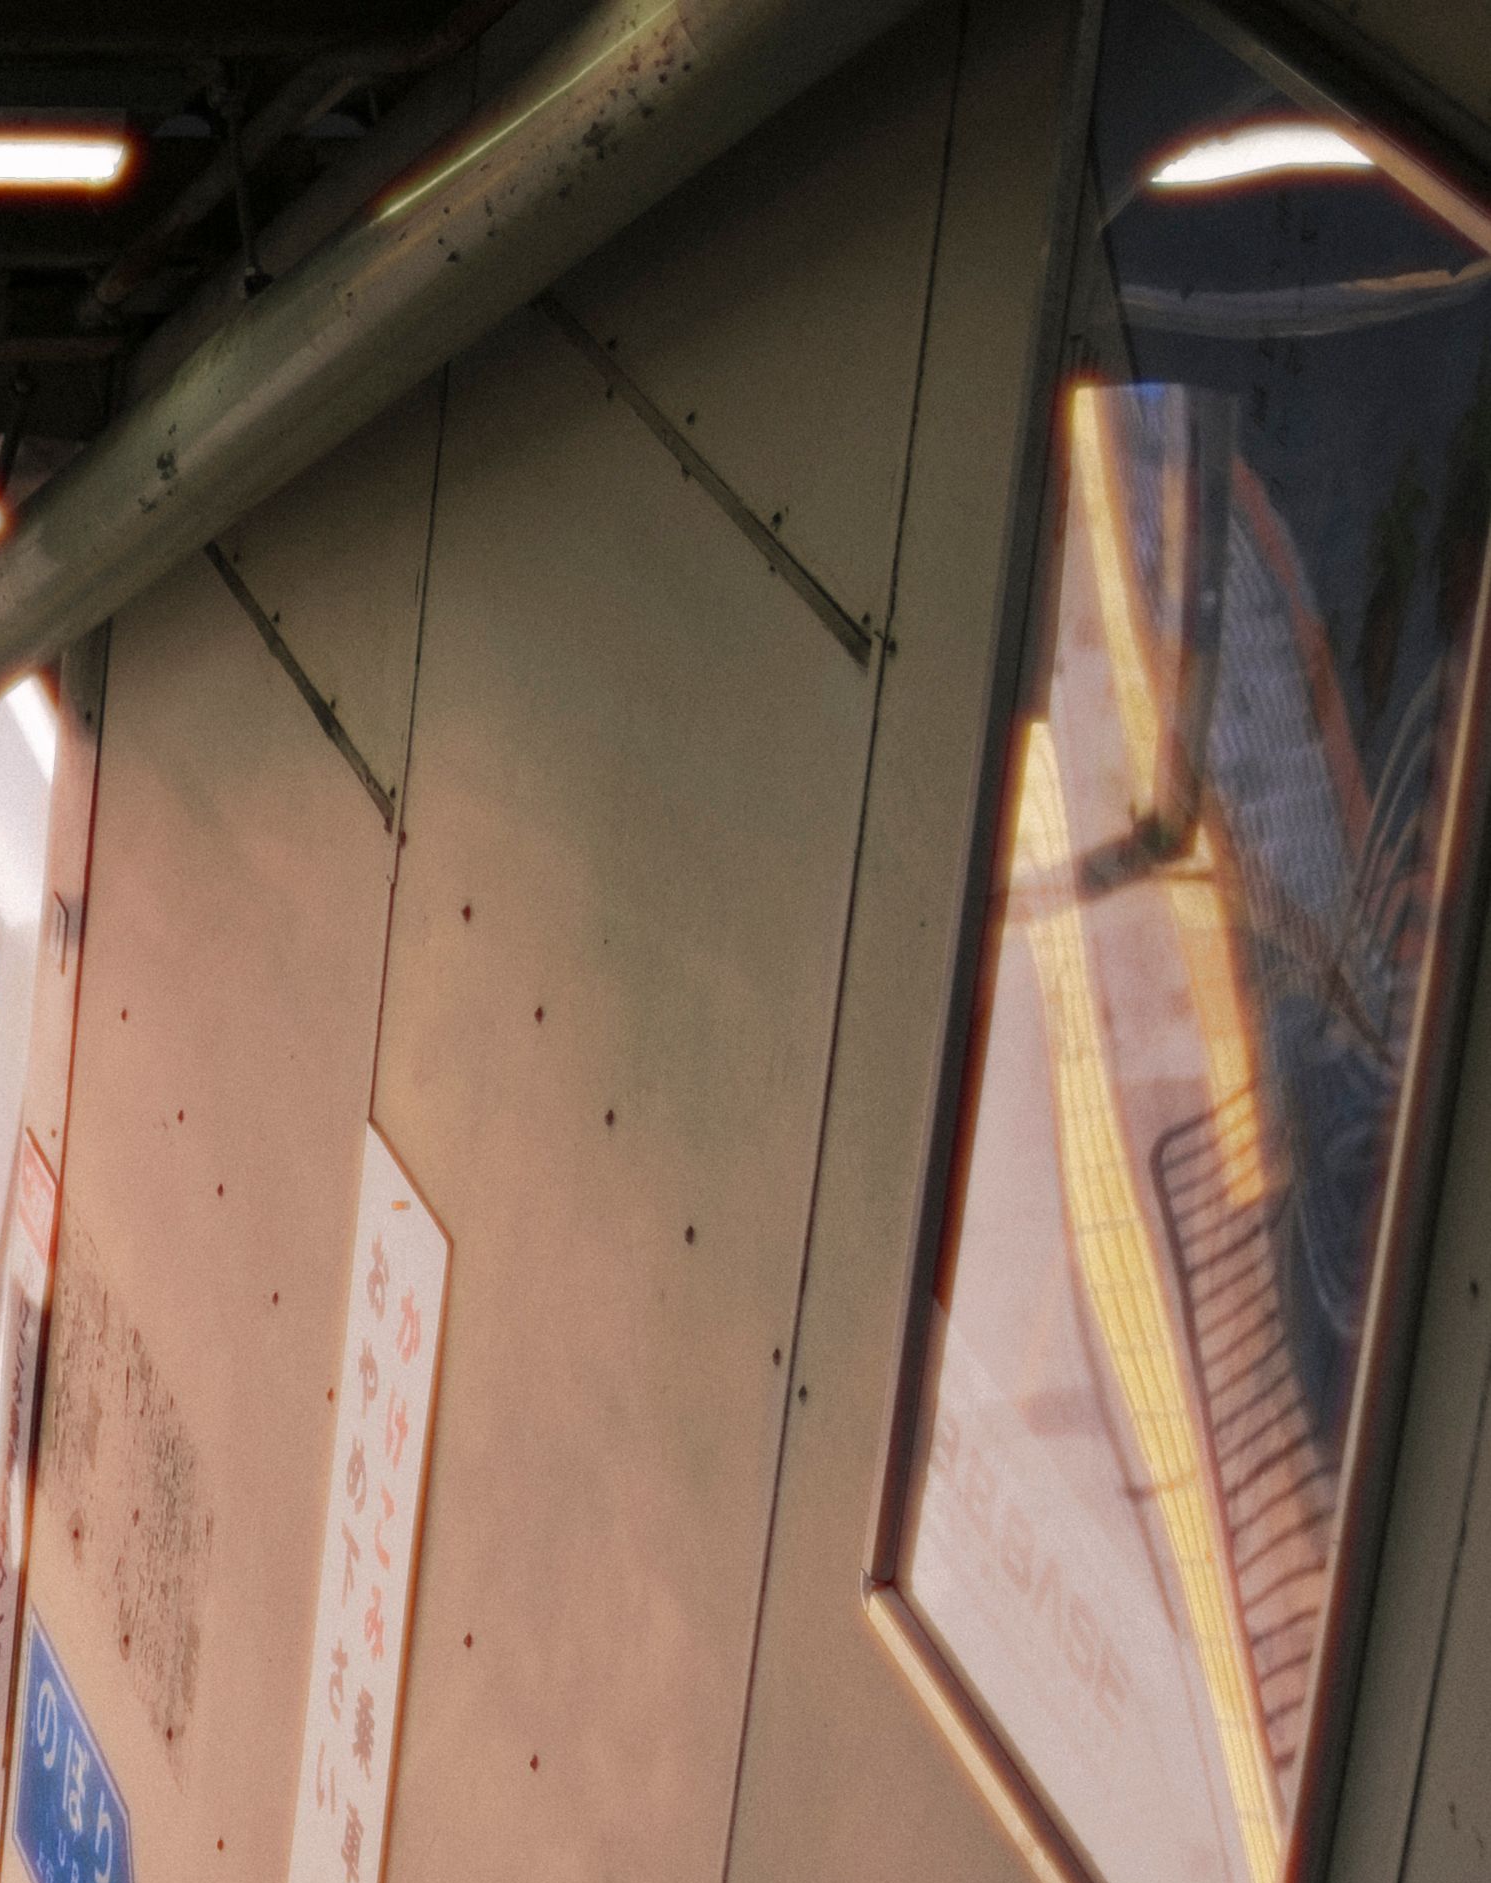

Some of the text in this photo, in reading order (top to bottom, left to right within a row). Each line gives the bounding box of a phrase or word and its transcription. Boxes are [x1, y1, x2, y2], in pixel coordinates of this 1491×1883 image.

[314, 1228, 391, 1814] おやめ下さい
